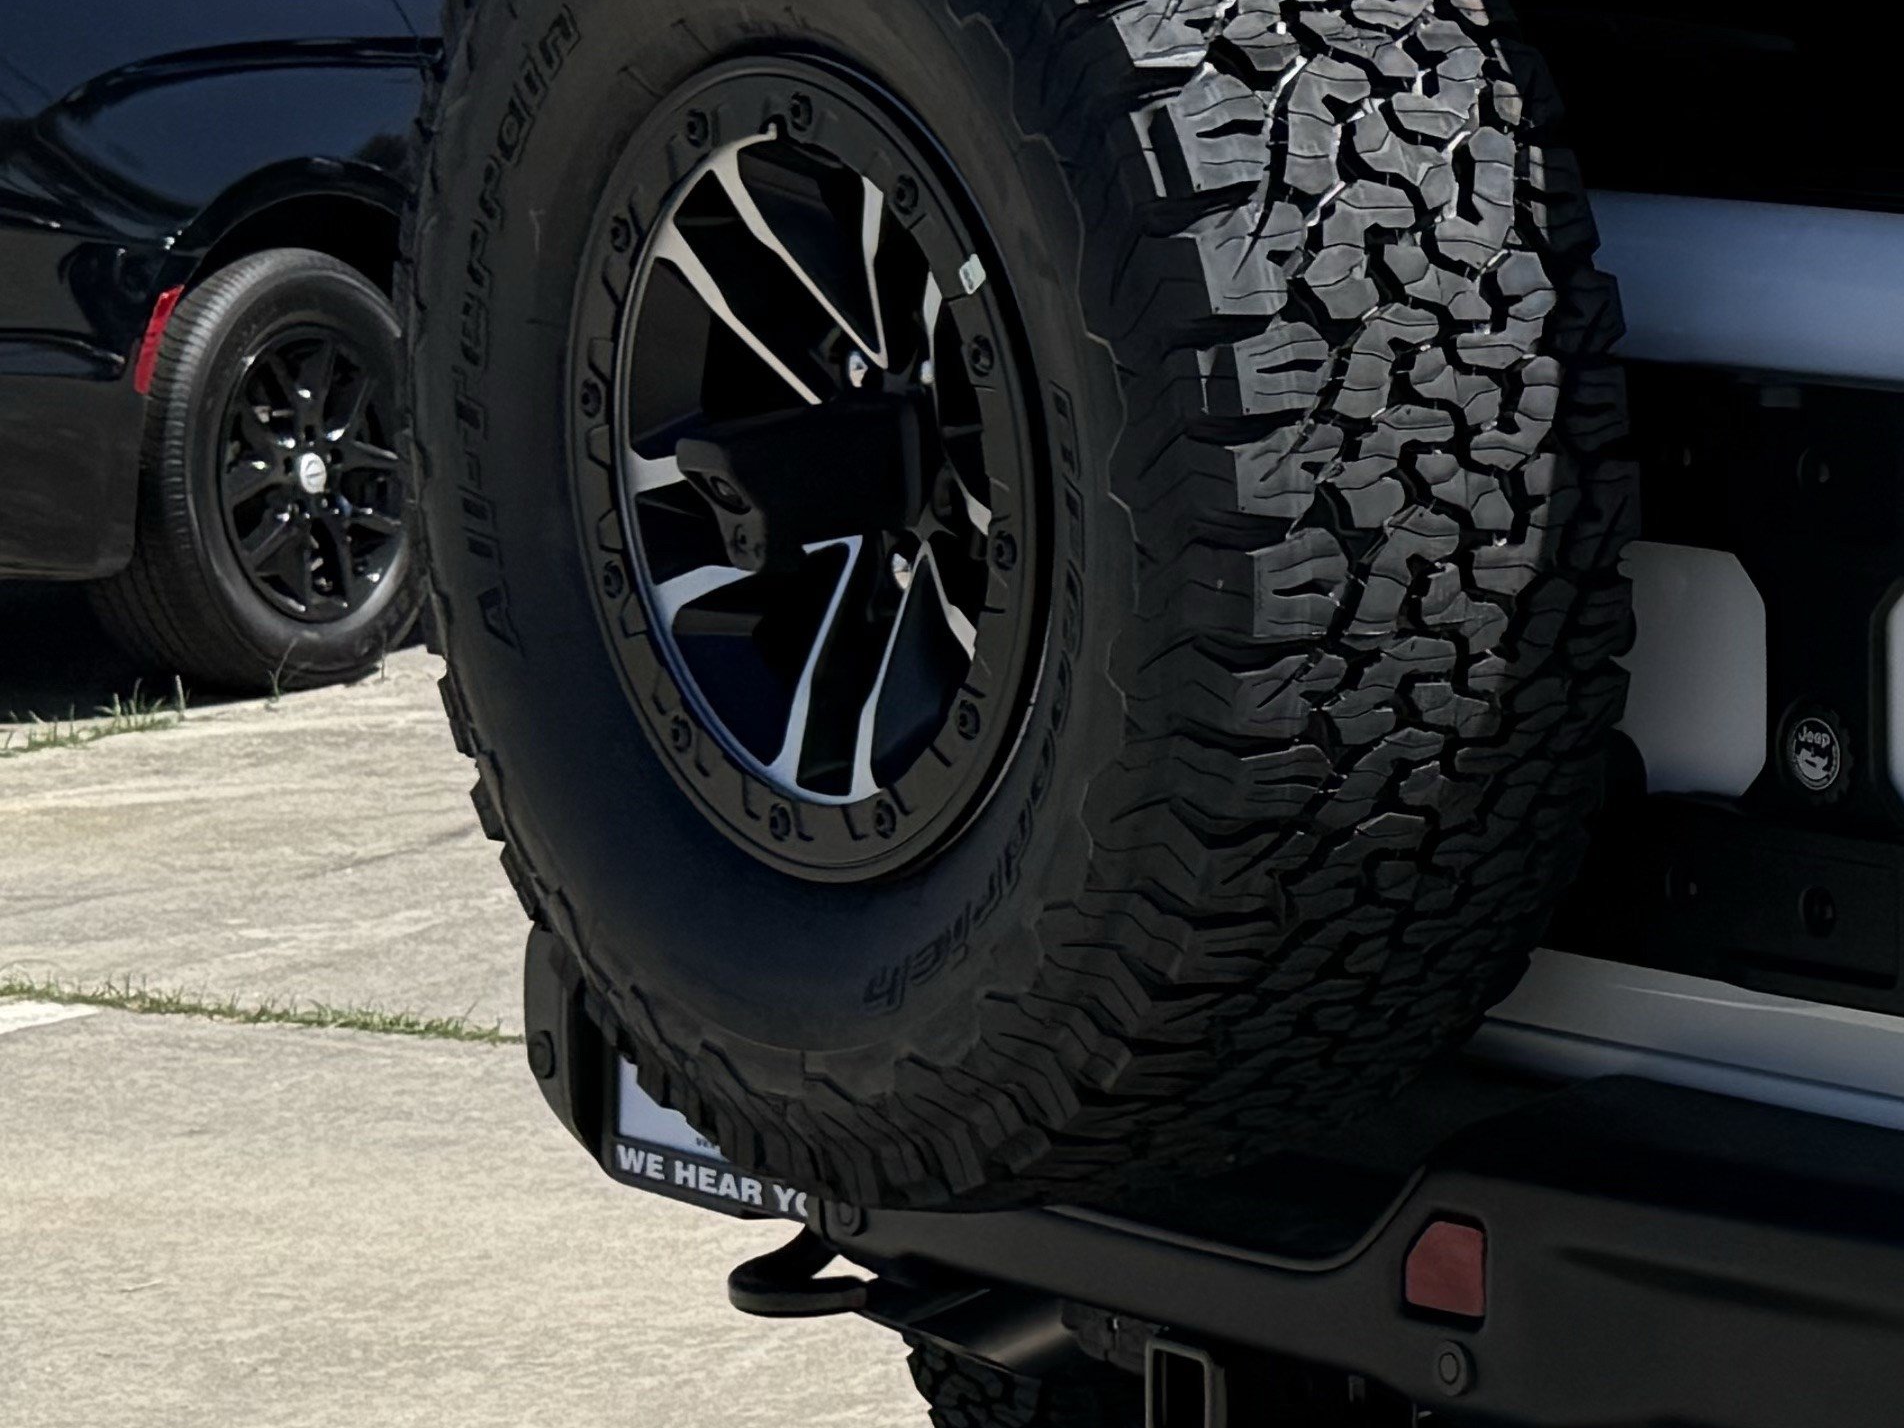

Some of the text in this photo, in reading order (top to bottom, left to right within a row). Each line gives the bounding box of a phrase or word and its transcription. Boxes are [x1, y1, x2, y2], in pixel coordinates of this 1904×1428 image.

[453, 0, 582, 656] All-Terrain
[862, 377, 1087, 1017] BFGoodrich
[1798, 725, 1831, 749] Jeep
[615, 1143, 665, 1181] WE
[673, 1159, 763, 1206] HEAR
